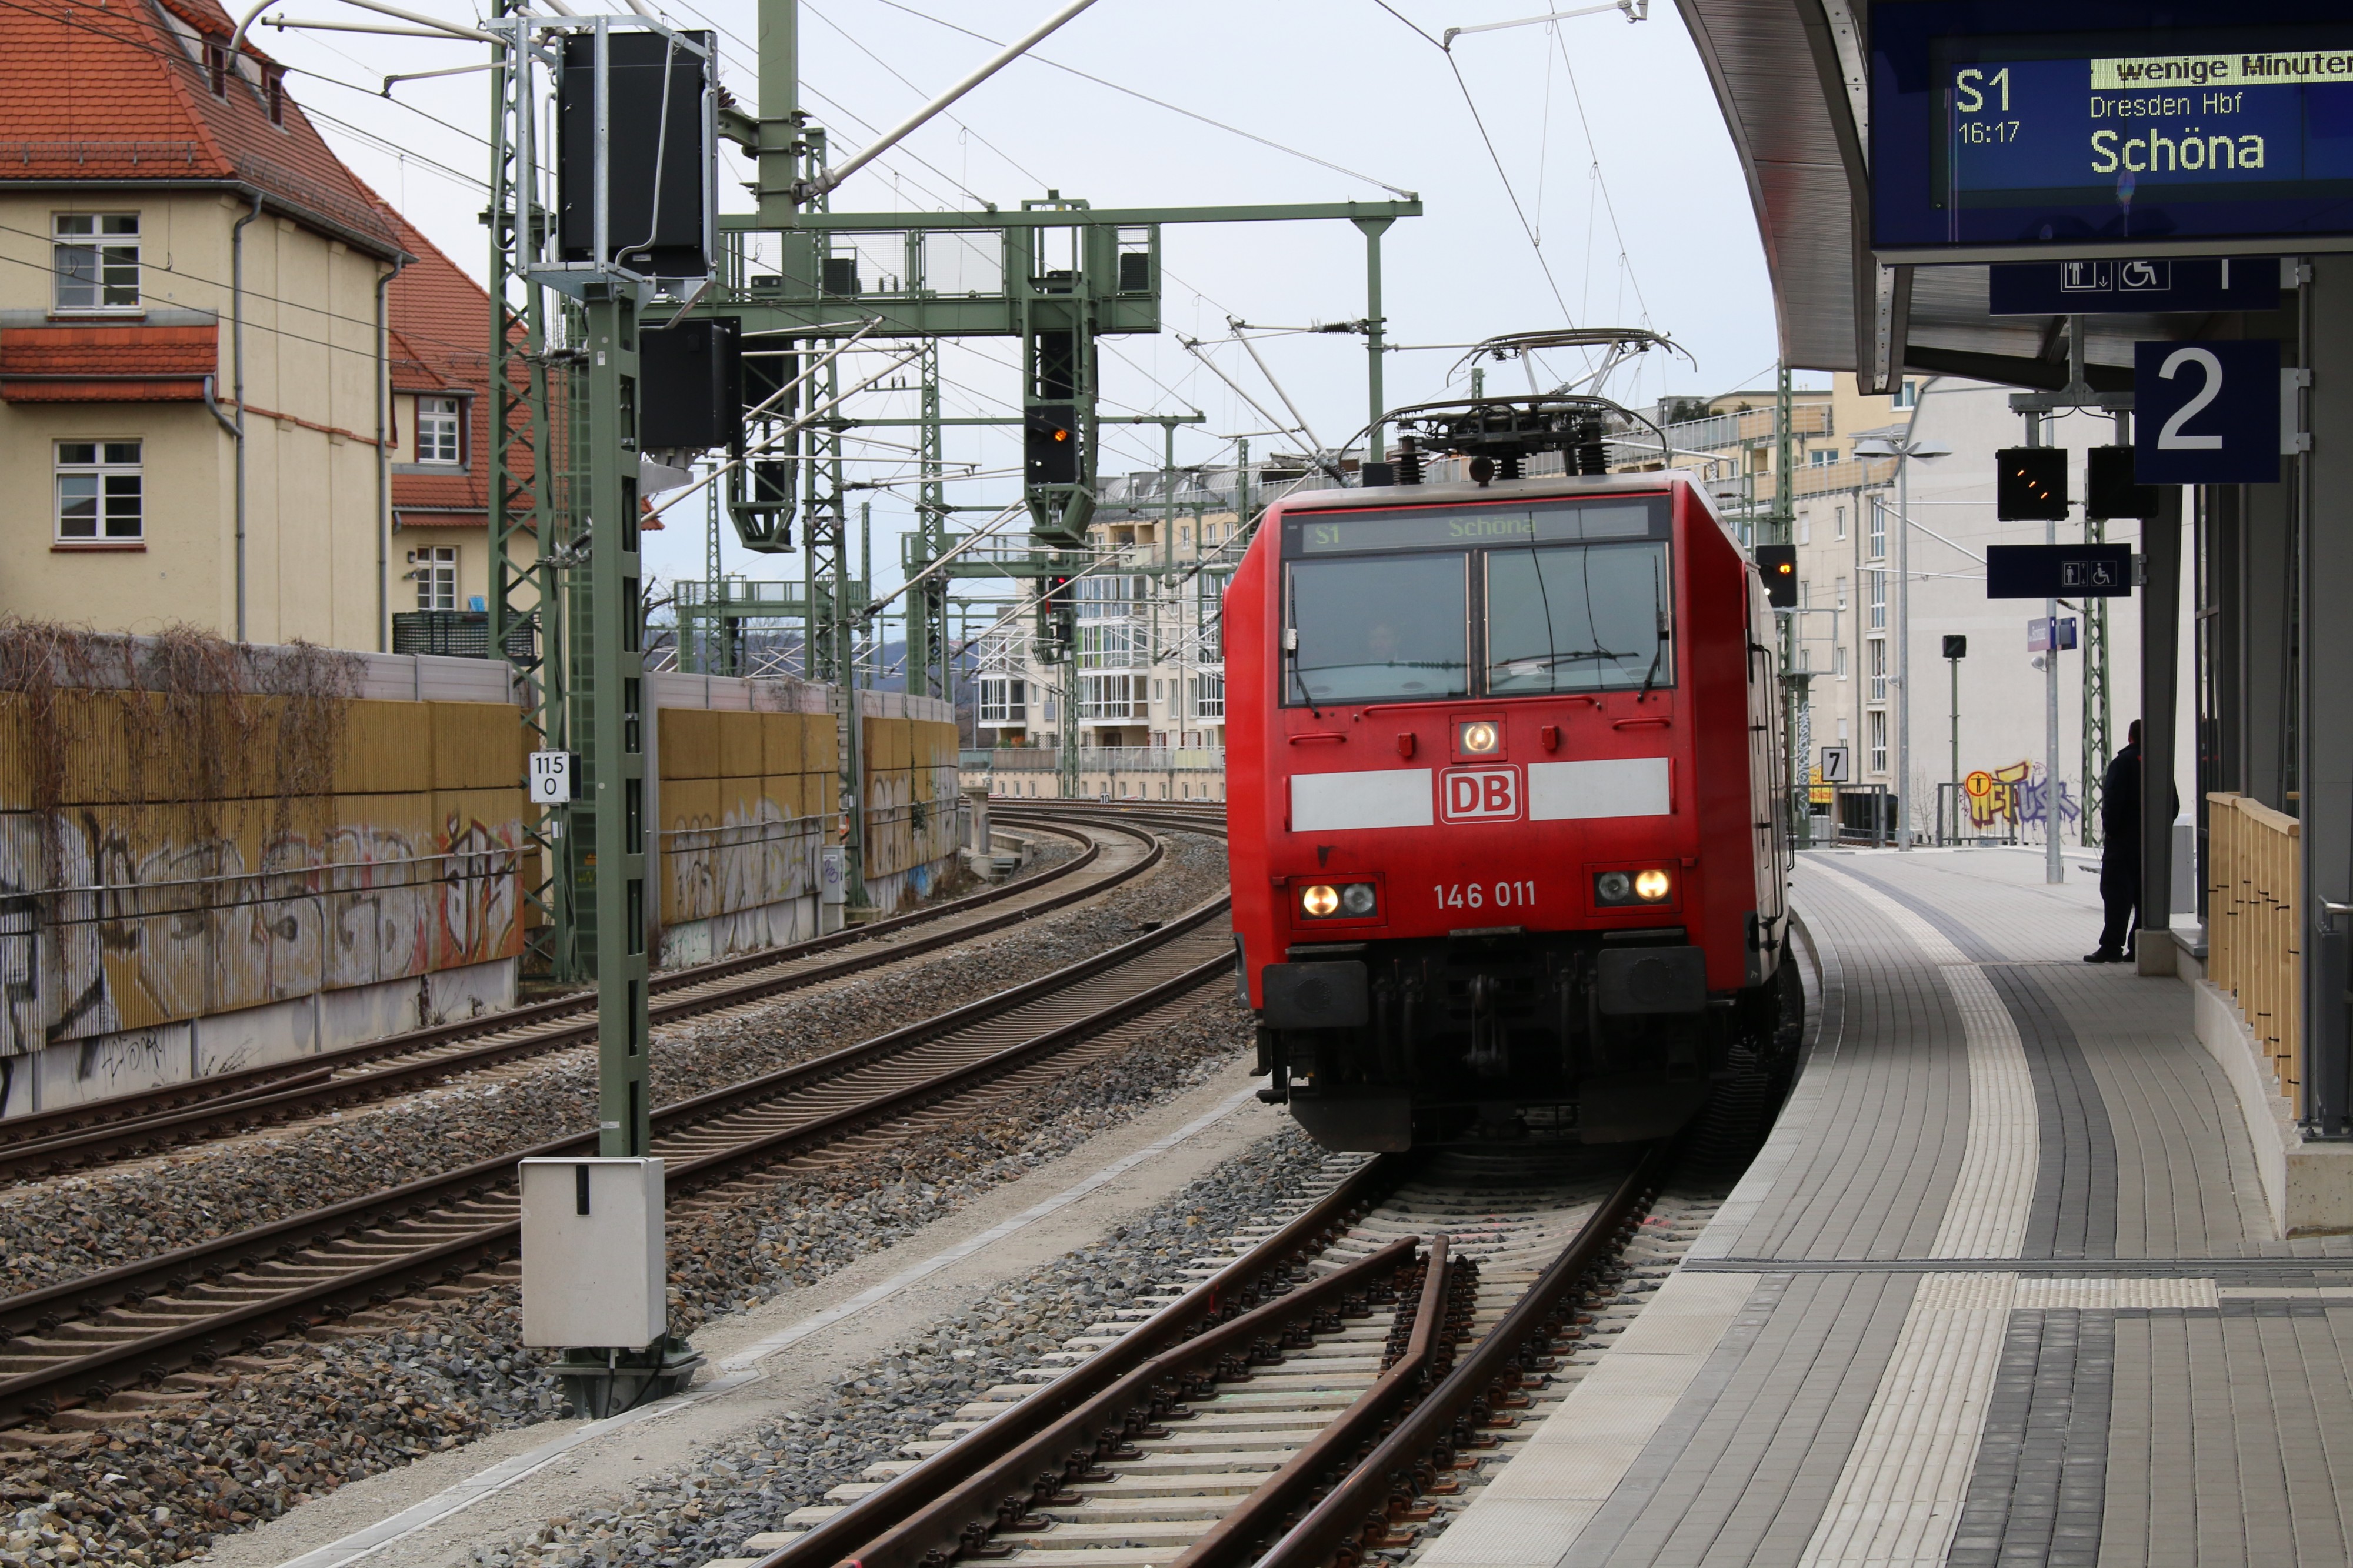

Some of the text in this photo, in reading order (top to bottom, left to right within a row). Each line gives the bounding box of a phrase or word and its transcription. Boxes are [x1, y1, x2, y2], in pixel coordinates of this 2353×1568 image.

[2117, 58, 2228, 84] wenige
[1957, 68, 2009, 112] S1
[2091, 92, 2243, 118] Dresden Hbf
[1959, 121, 2019, 144] 16:17
[2091, 126, 2264, 173] Schöna
[2157, 347, 2223, 450] 2
[1315, 525, 1340, 545] S1
[1449, 516, 1537, 538] Schöna
[535, 756, 564, 774] 115
[1829, 752, 1841, 777] 7
[544, 778, 556, 795] 0
[1451, 775, 1511, 813] DB
[1101, 795, 1109, 804] 10
[1434, 880, 1535, 909] 146 011
